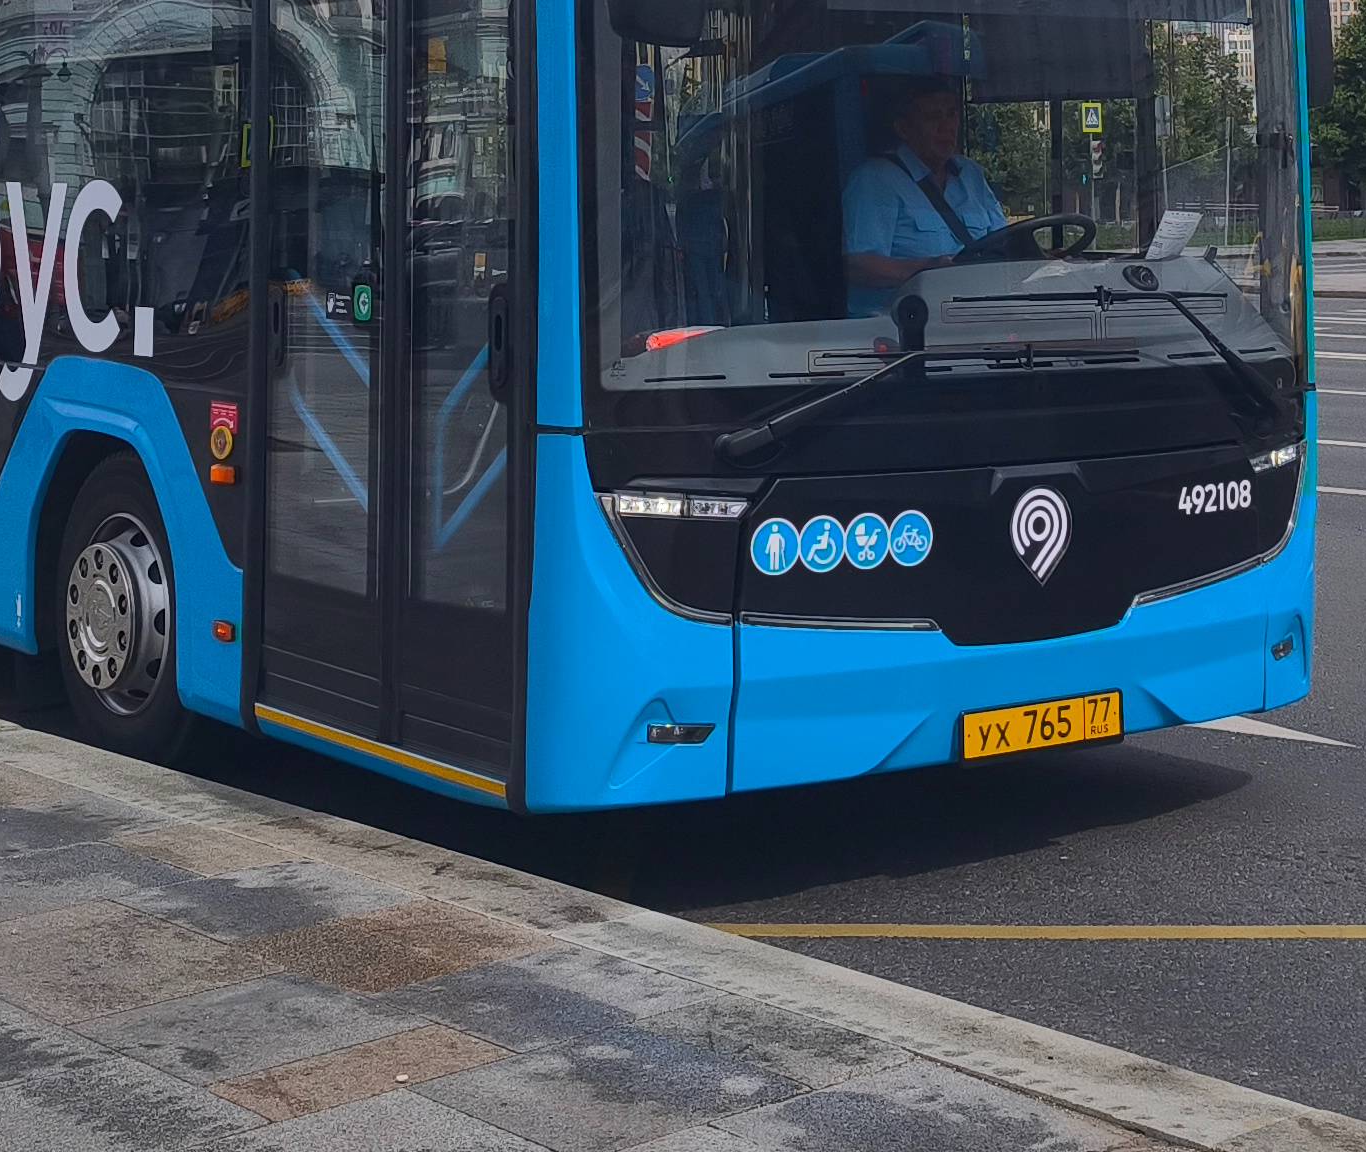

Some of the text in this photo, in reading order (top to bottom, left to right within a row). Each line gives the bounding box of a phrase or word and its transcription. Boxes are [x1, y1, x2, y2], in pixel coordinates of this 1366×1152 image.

[1178, 479, 1252, 516] 492108
[1023, 704, 1072, 745] 765
[1087, 697, 1111, 725] 77
[1090, 723, 1109, 735] RUS
